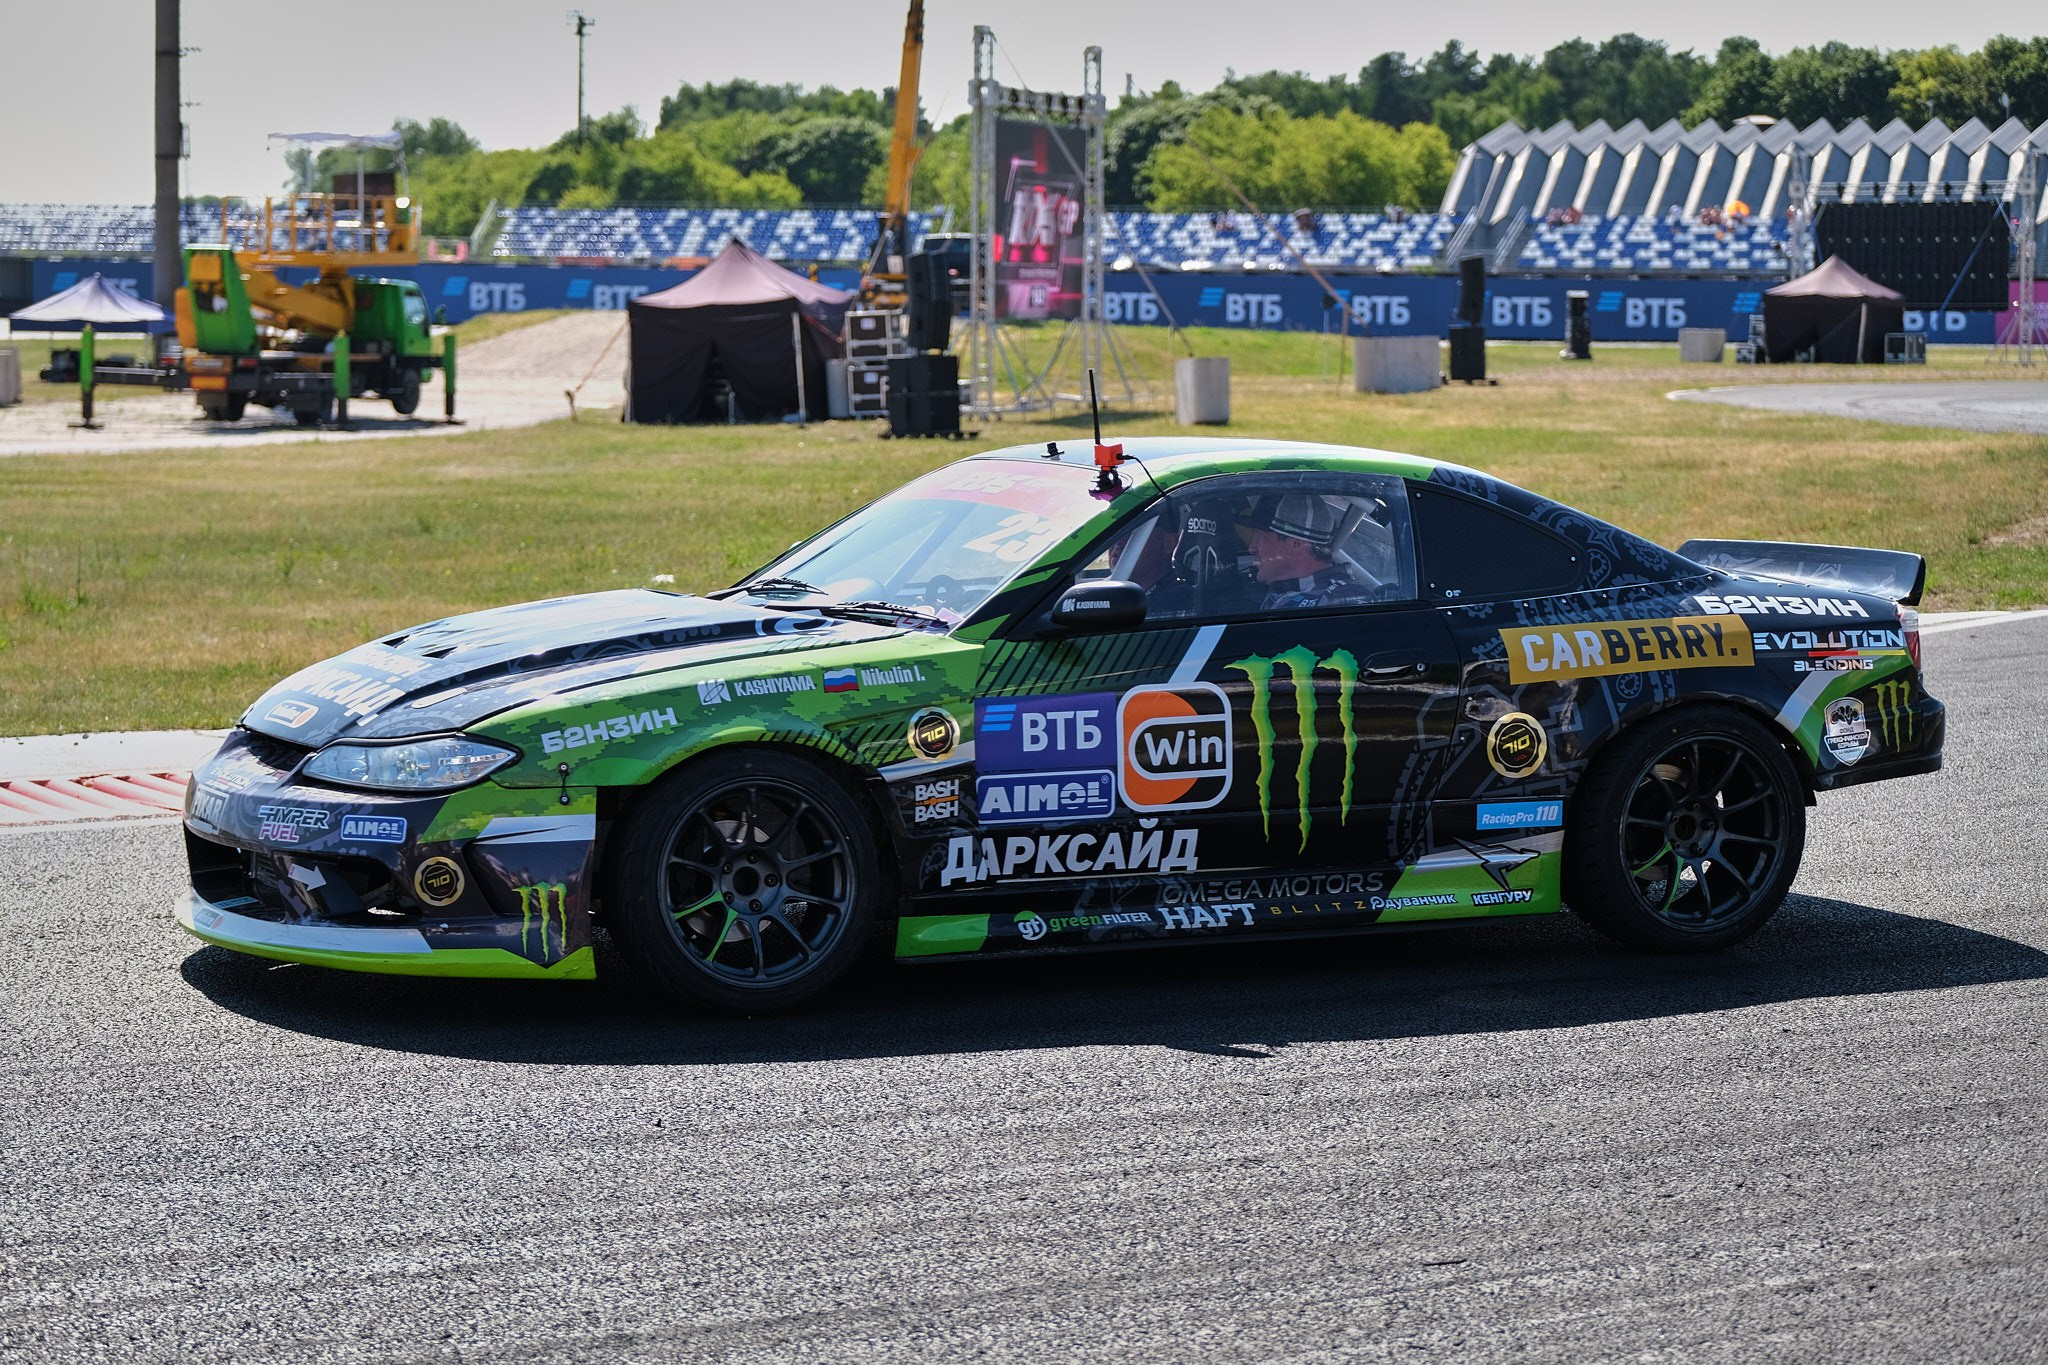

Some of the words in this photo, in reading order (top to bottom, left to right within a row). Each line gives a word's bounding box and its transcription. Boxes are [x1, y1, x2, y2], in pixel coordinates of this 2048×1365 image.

[469, 282, 527, 312] ВТБ
[1103, 291, 1159, 322] ВТБ
[1225, 293, 1283, 324] ВТБ
[1350, 295, 1411, 326] ВТБ
[1491, 295, 1553, 328] ВТБ
[1625, 297, 1688, 329] ВТБ
[1187, 517, 1217, 533] sparco
[1753, 628, 1905, 650] EVOLUTION
[1793, 658, 1874, 672] BLENDING
[734, 674, 816, 697] KASHIYAMA
[861, 665, 914, 687] Nikulin
[1021, 709, 1102, 752] ВТБ
[1144, 729, 1223, 766] Win
[914, 779, 960, 802] BASH
[979, 781, 1109, 814] AIMOL
[258, 805, 331, 830] HYPER
[914, 800, 960, 823] BASH
[1481, 811, 1535, 826] RacingPro
[1536, 804, 1560, 822] 110
[258, 823, 301, 843] FUEL
[343, 820, 403, 838] AIMOL
[941, 817, 1199, 887] ДАРКСАЙД
[1163, 879, 1264, 904] OMEGA
[1268, 872, 1384, 899] MOTORS
[1472, 889, 1533, 906] КЕНГУРУ
[1158, 902, 1257, 930] HAFT
